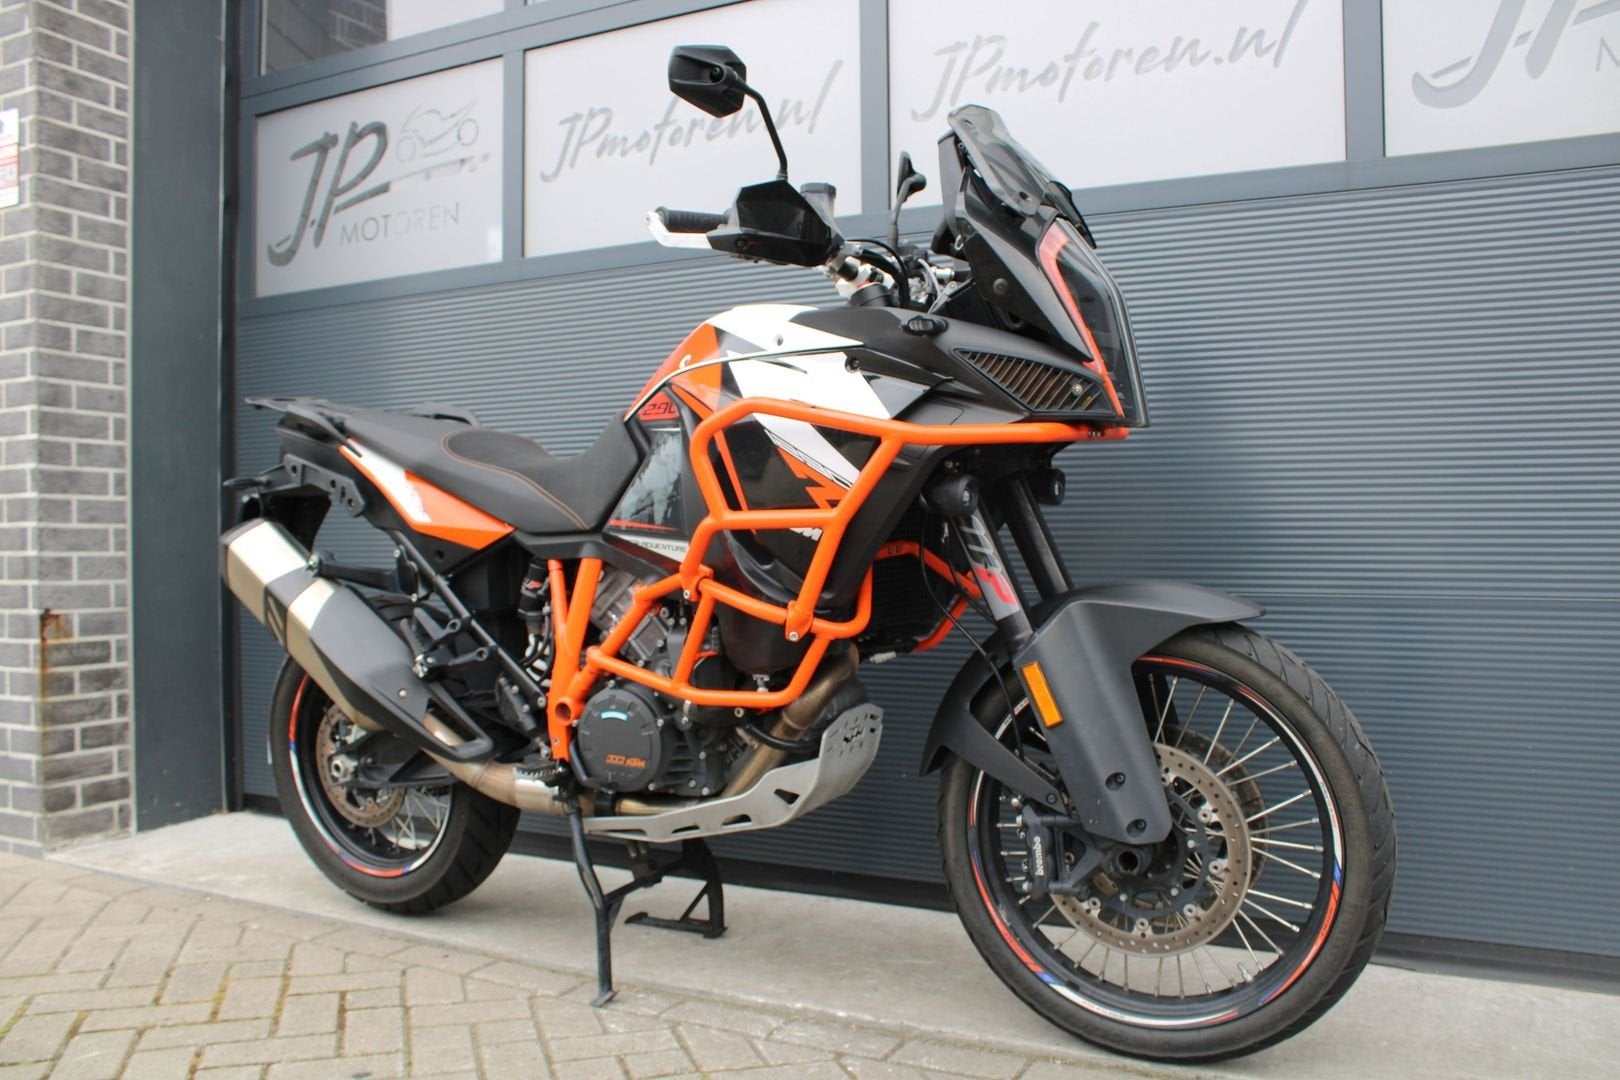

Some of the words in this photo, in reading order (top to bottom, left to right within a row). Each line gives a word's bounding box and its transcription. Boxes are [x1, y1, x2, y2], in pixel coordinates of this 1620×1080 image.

[540, 59, 844, 183] JPmotorennl
[911, 0, 1308, 123] JPmotoren.nl
[338, 200, 460, 247] MOTOREN
